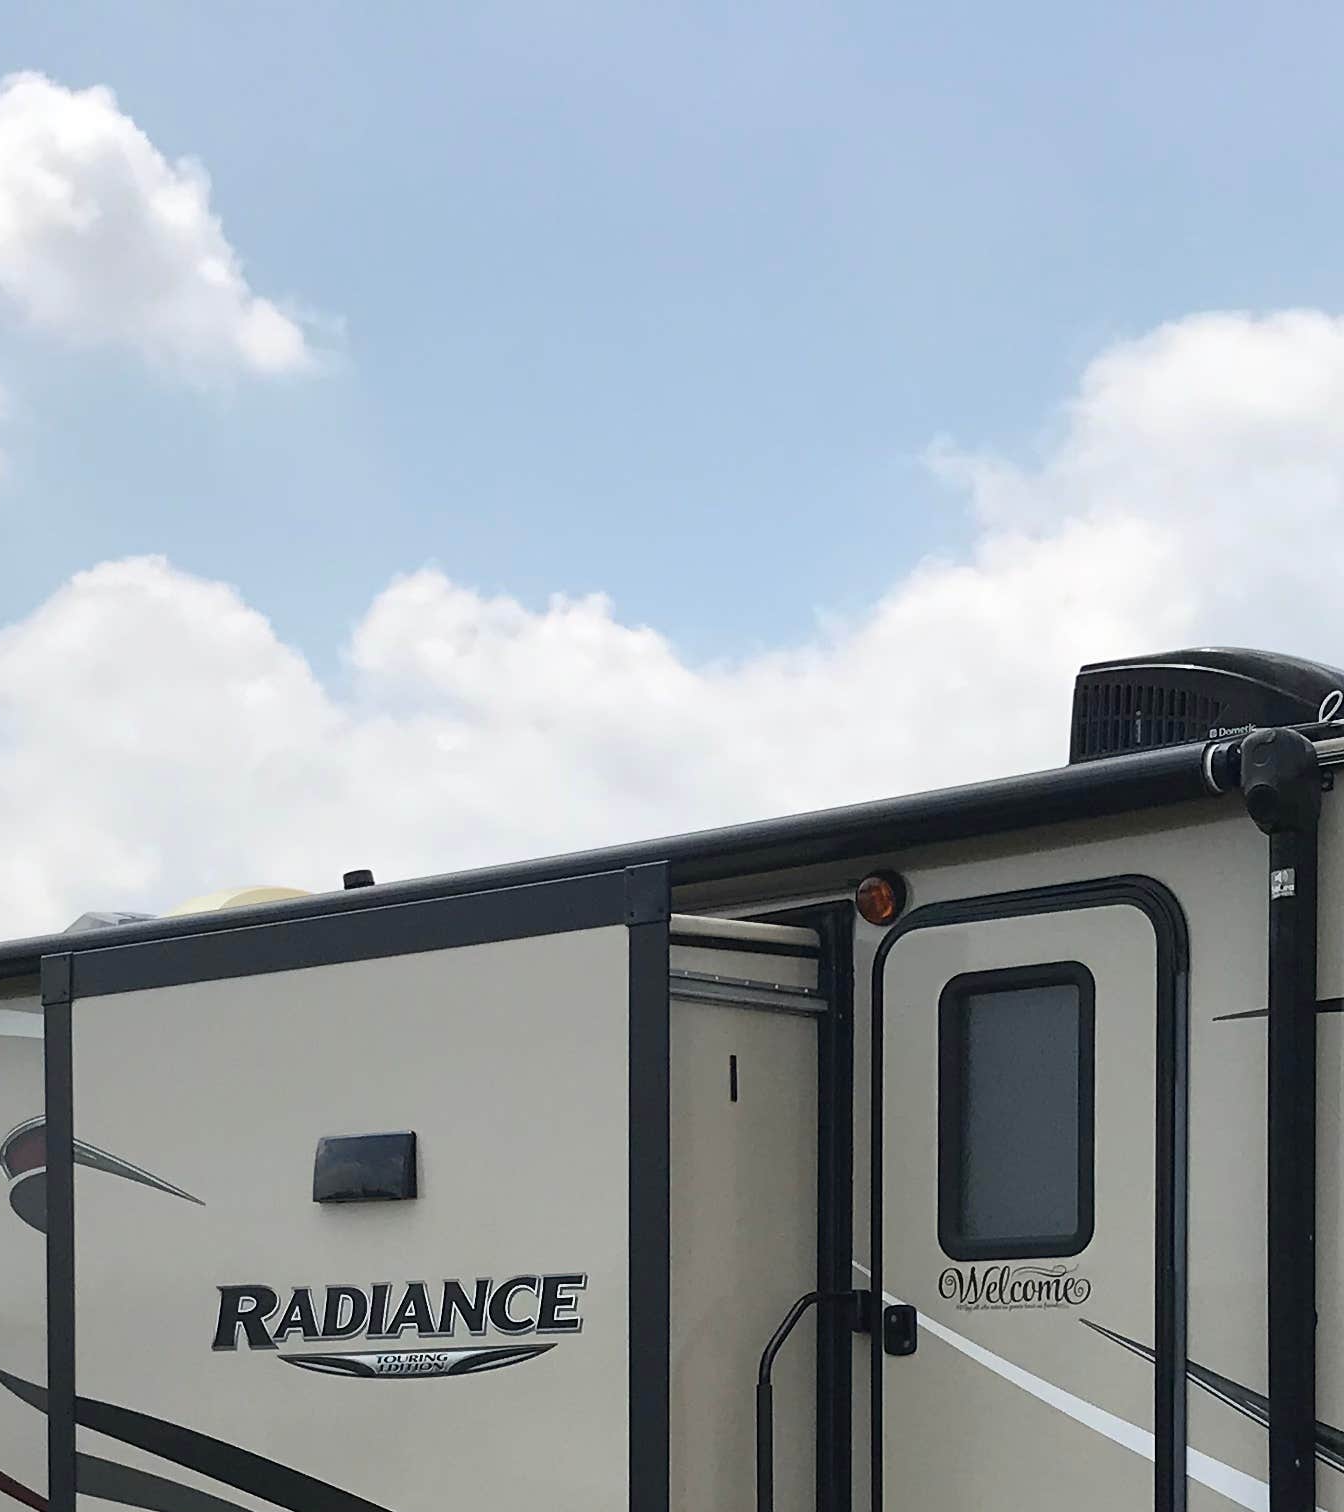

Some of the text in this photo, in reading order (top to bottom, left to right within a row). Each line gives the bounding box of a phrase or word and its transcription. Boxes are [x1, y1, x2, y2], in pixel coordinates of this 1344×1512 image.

[938, 1264, 1091, 1305] Welcome
[212, 1272, 588, 1351] RADIANCE
[376, 1353, 448, 1364] TOURING
[378, 1362, 445, 1373] EDITION
